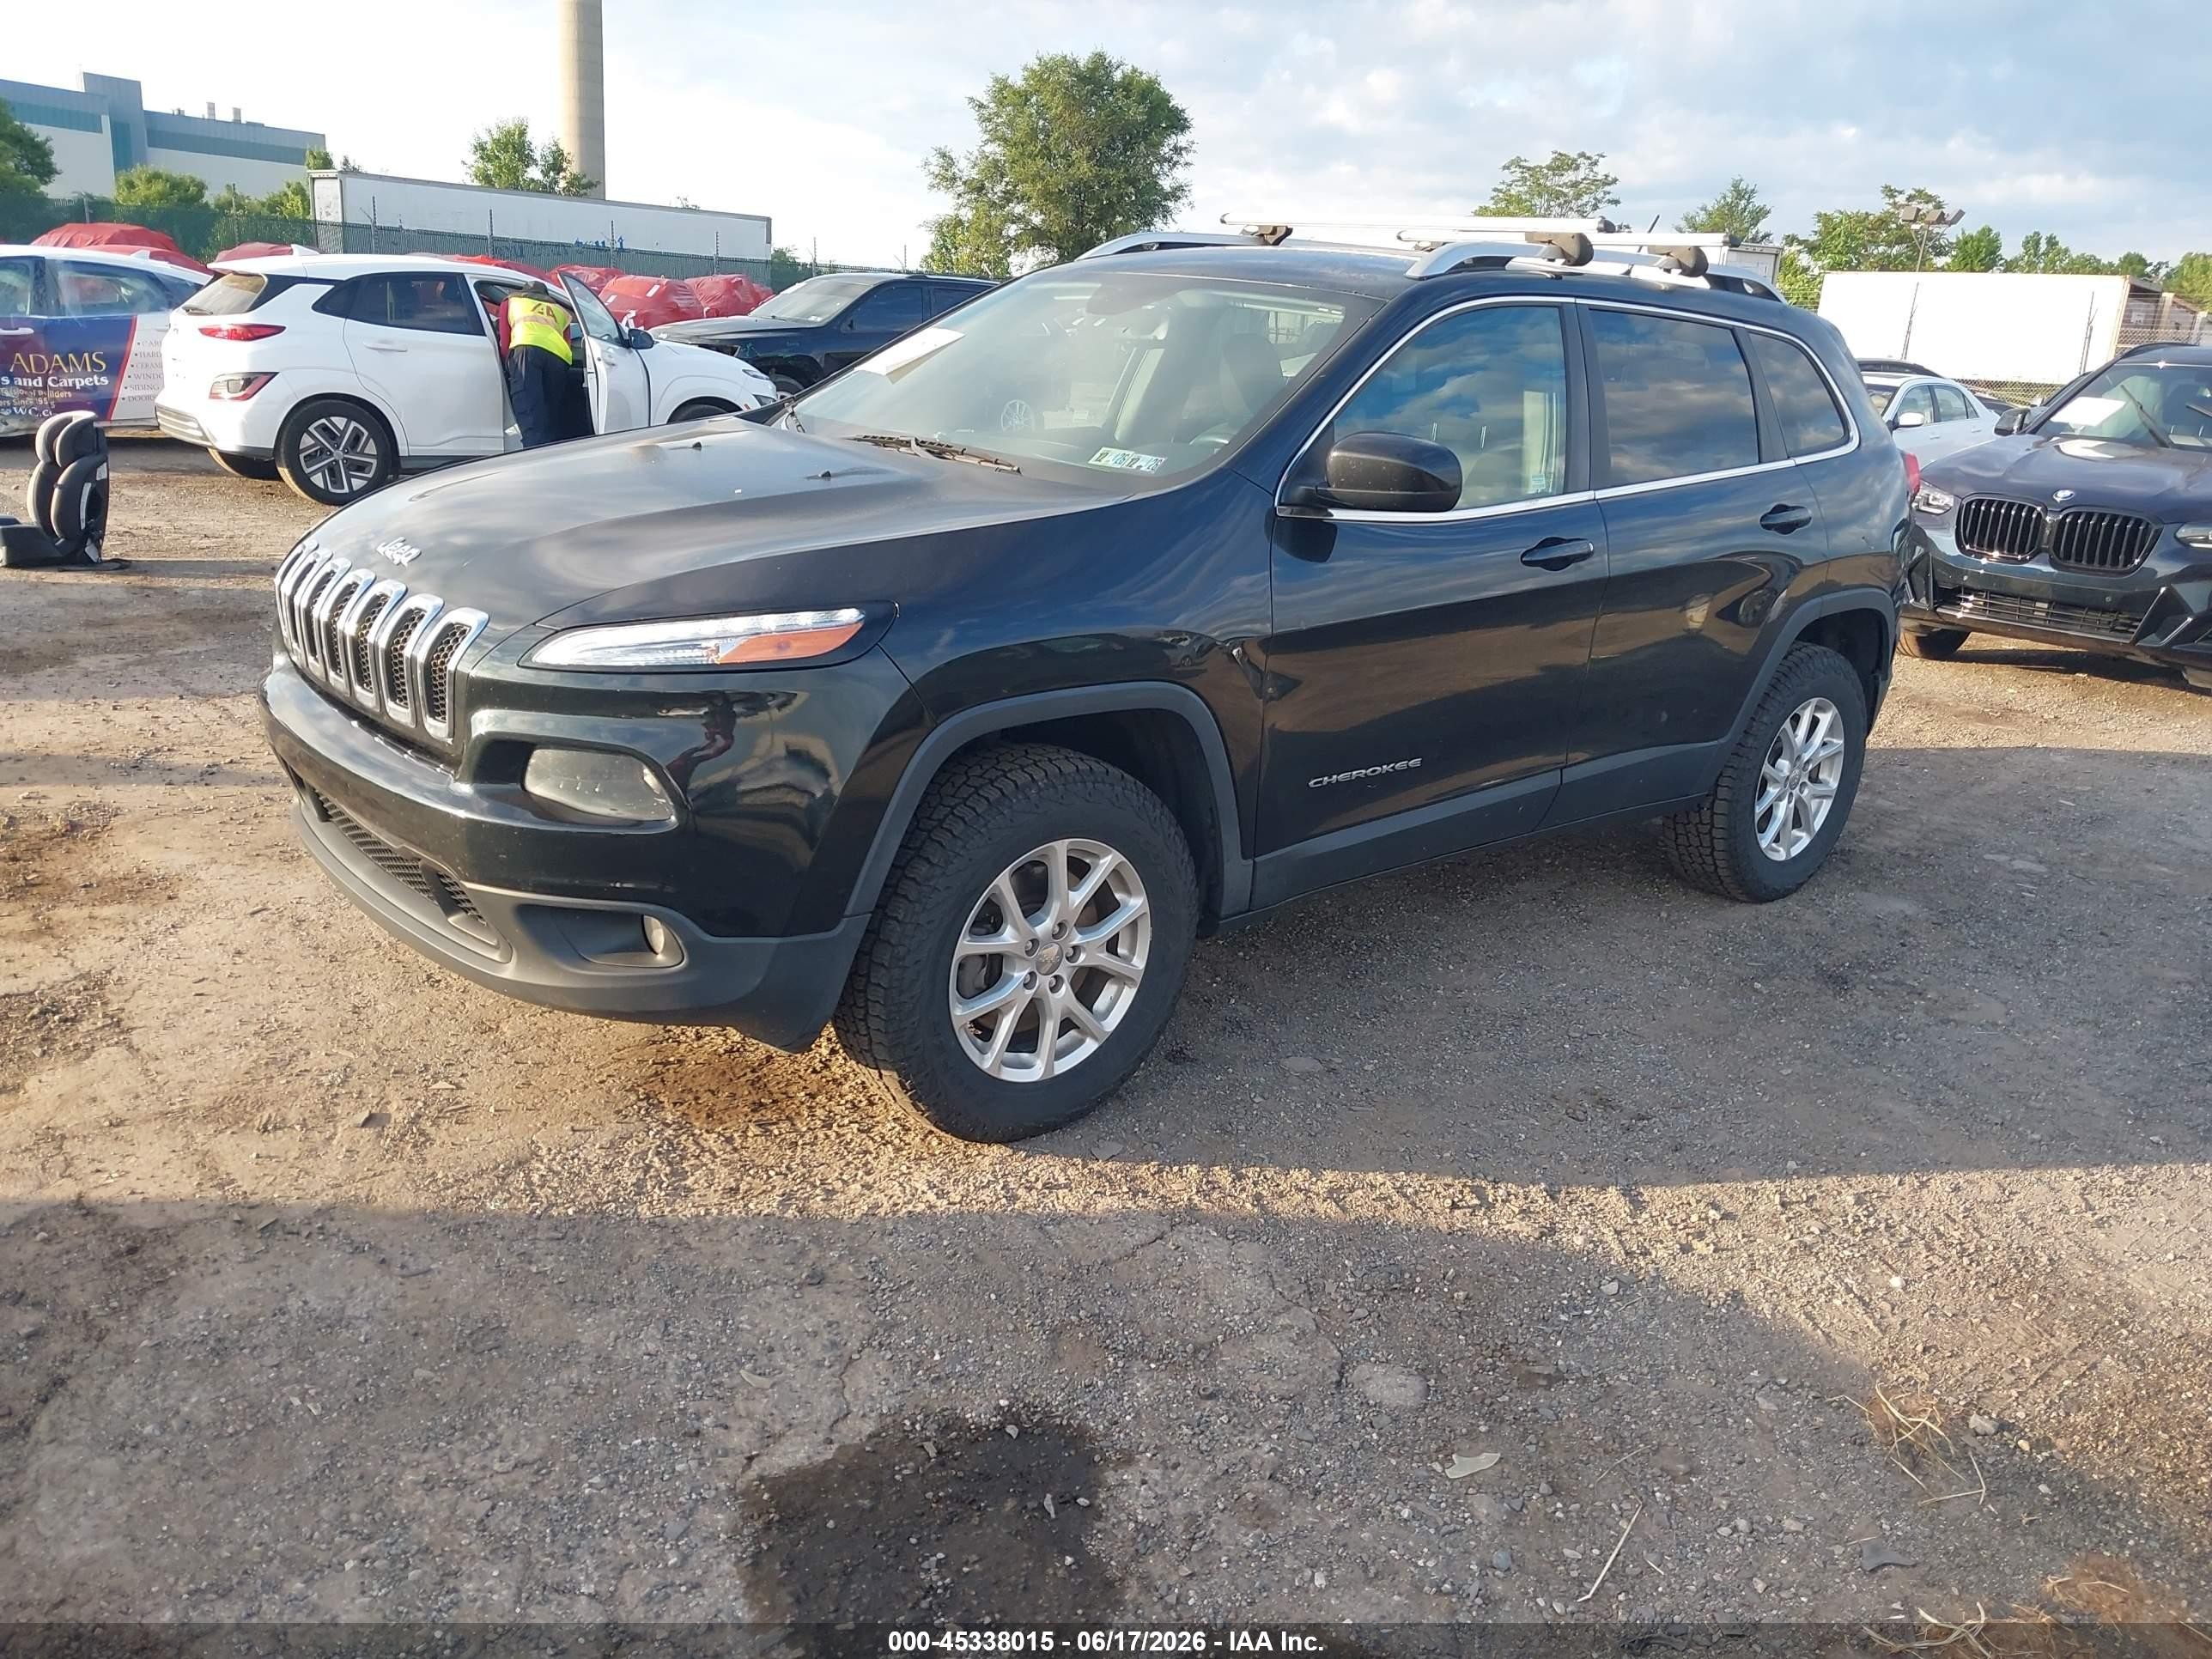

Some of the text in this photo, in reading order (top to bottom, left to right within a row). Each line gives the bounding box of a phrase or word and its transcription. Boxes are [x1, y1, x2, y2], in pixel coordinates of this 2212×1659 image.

[9, 351, 107, 374] ADAMS
[14, 376, 43, 388] and
[47, 374, 109, 390] Carpets
[376, 537, 422, 568] Jeep
[1308, 757, 1423, 788] CHEROKEE
